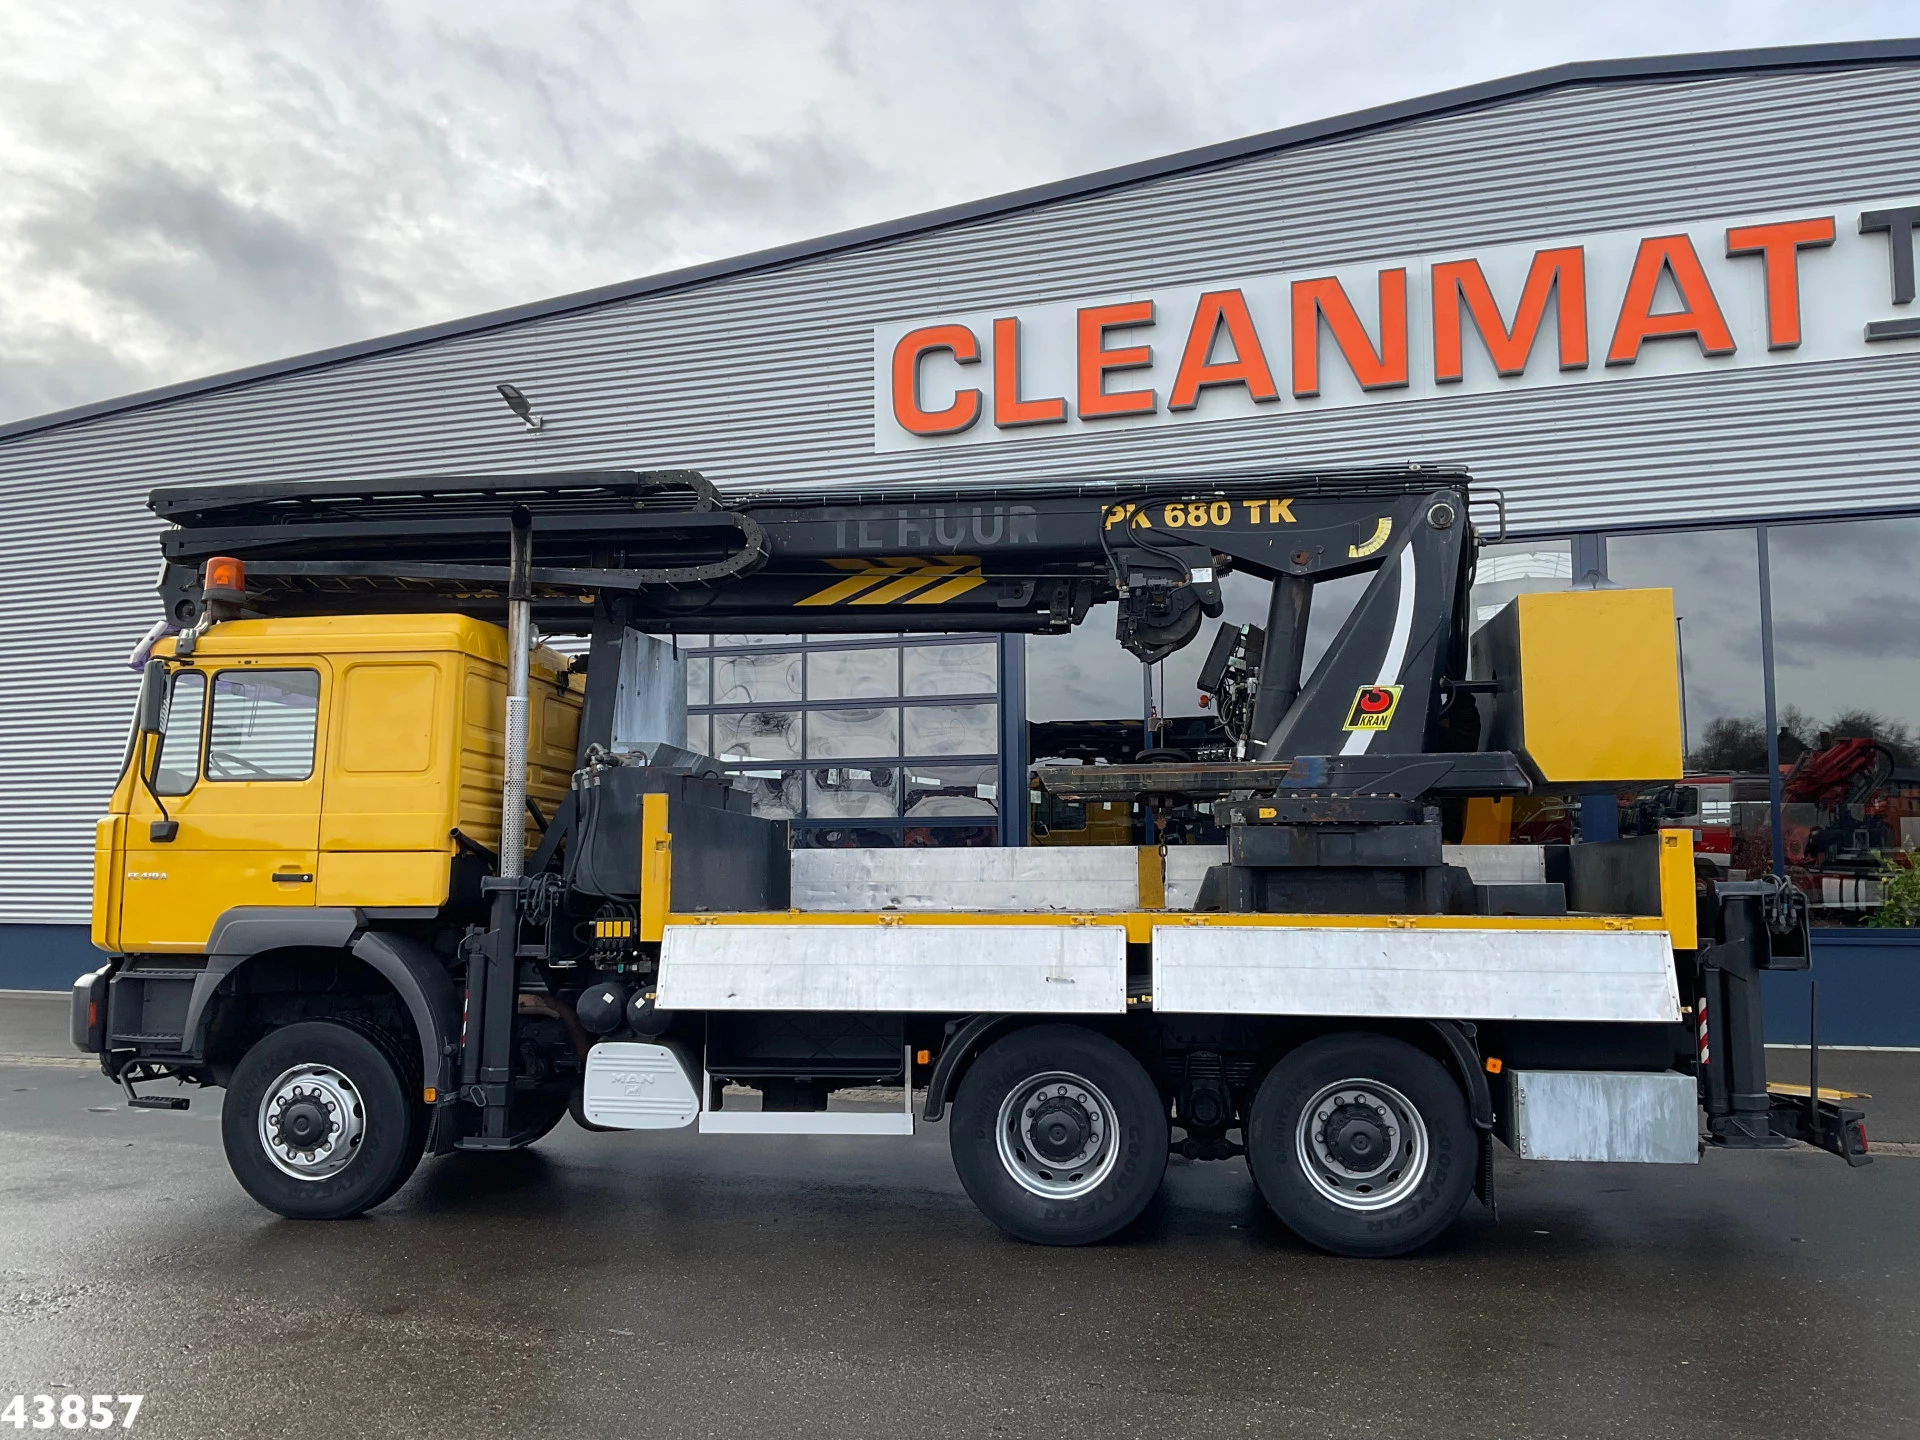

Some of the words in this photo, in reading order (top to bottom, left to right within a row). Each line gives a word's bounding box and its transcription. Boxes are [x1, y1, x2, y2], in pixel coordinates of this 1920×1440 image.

[891, 214, 1838, 438] CLEANMAT
[897, 504, 1039, 547] HUUR
[1101, 503, 1153, 531] PK
[1163, 500, 1232, 528] 680
[1242, 498, 1297, 524] TK
[1359, 714, 1388, 727] KRAN
